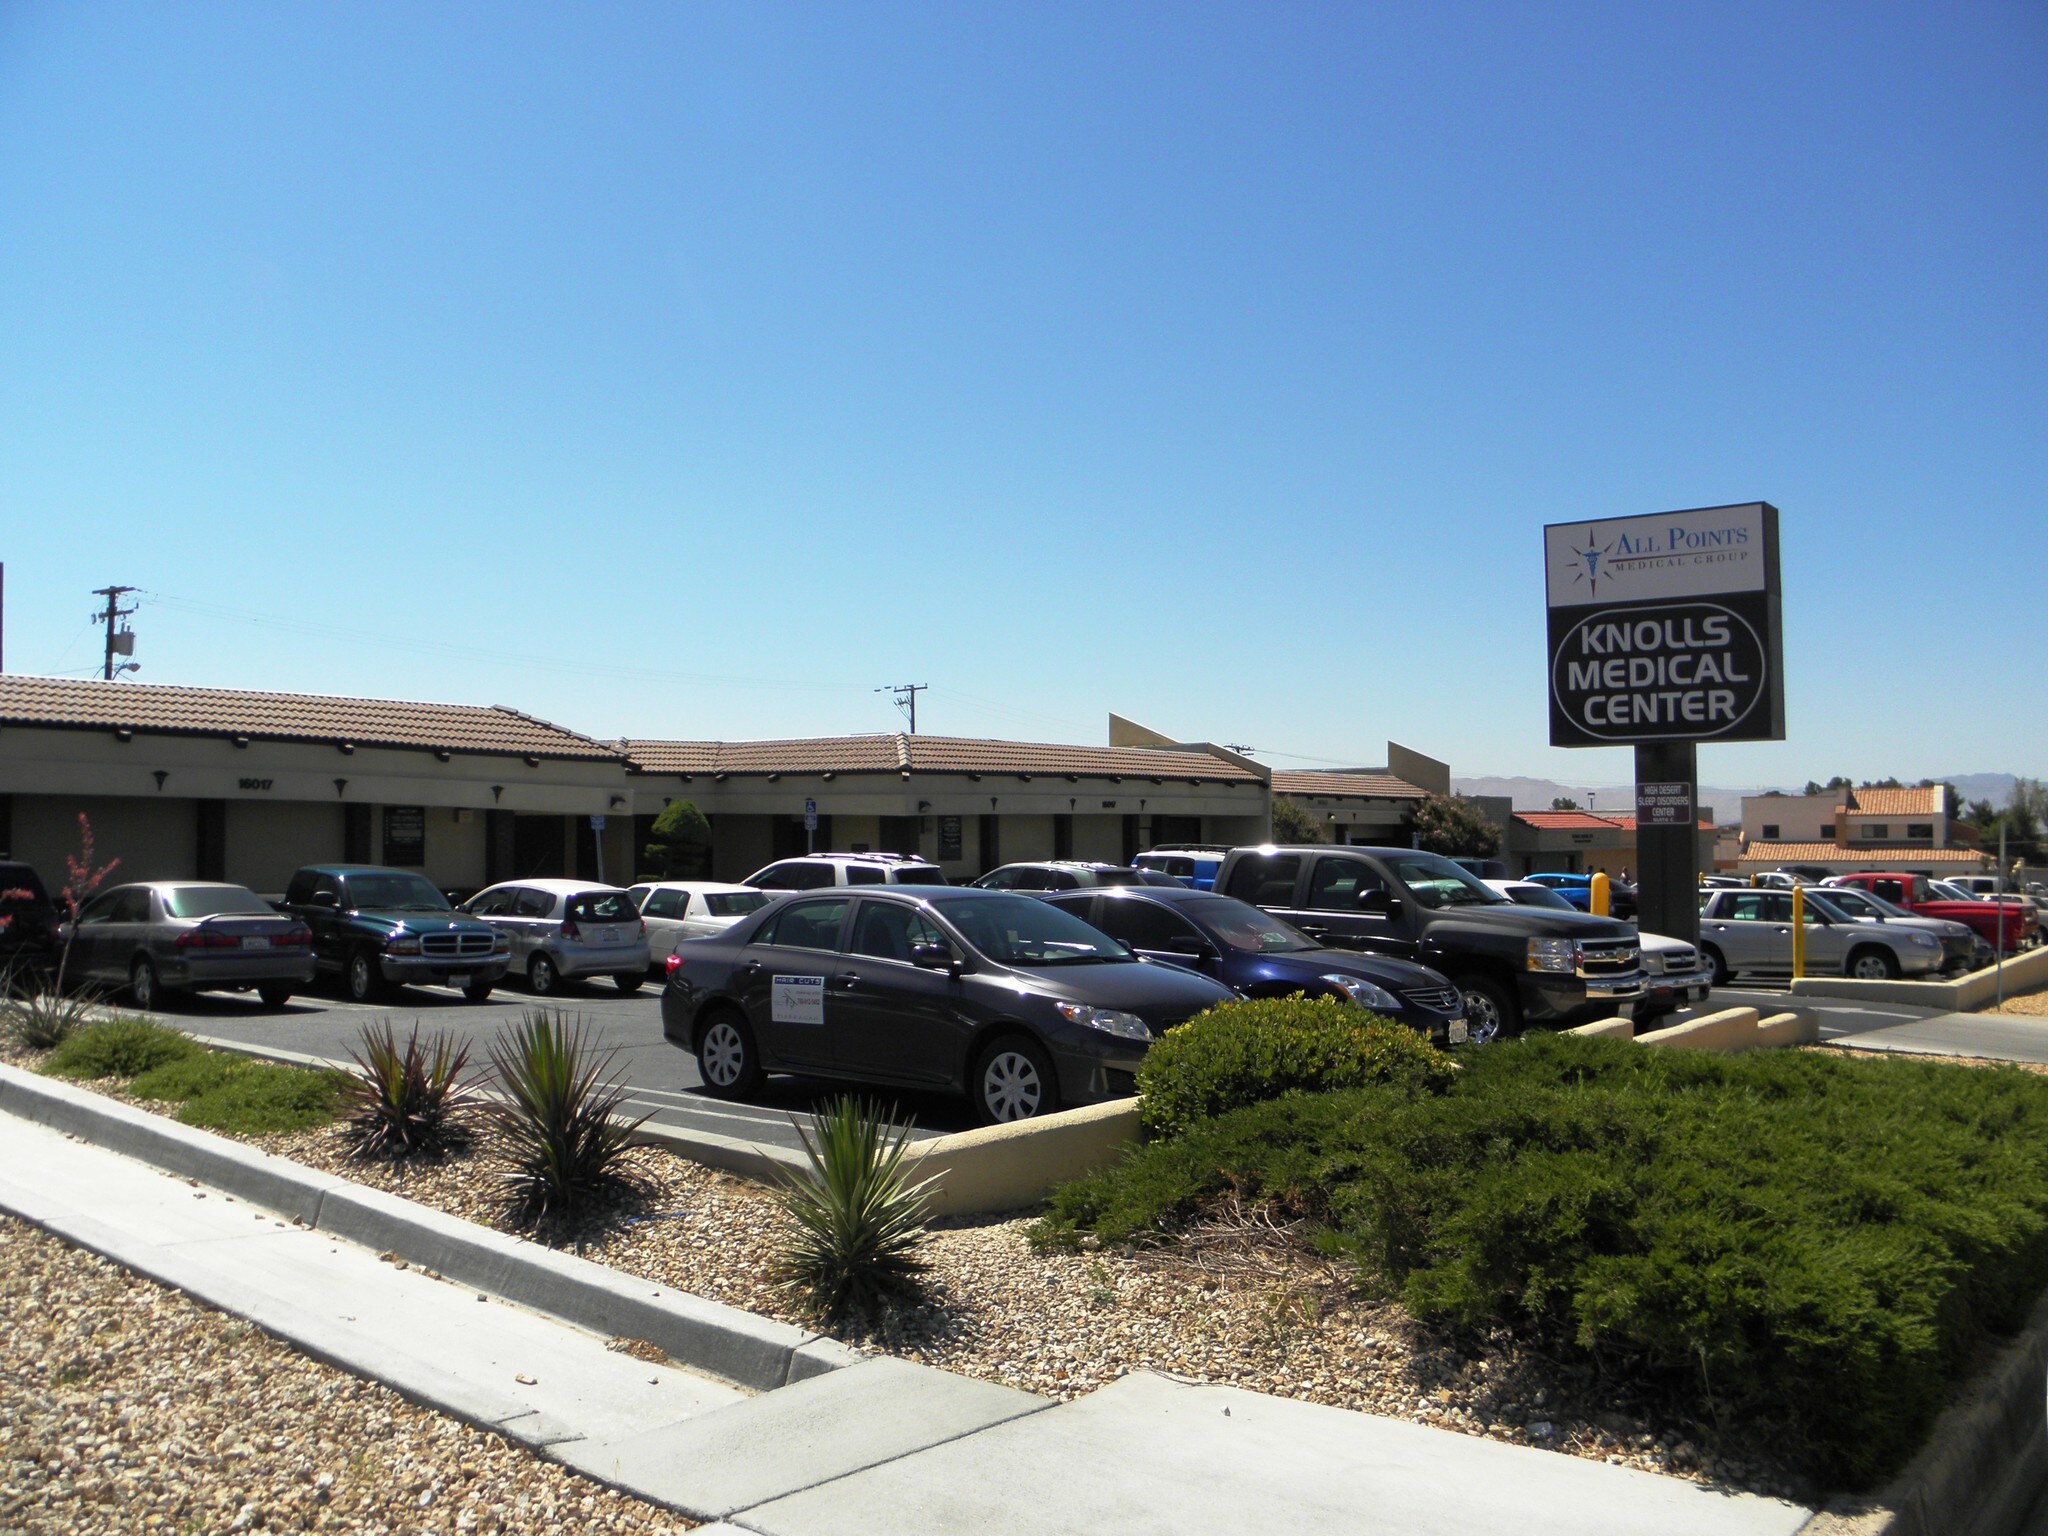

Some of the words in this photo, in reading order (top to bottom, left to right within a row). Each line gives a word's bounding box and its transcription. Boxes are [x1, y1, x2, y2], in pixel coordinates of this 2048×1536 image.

[1616, 532, 1661, 555] ALL
[1667, 526, 1748, 550] POINTS
[1615, 558, 1686, 572] MEDICAL
[1694, 551, 1748, 565] GROUP
[1581, 615, 1731, 655] KNOLLS
[1568, 652, 1749, 691] MEDICAL
[1583, 689, 1737, 726] CENTER
[1638, 796, 1656, 806] SLEEP
[1657, 795, 1689, 806] DISORDERS
[1644, 785, 1658, 795] HIGH
[1659, 784, 1682, 795] DESERT
[1652, 807, 1675, 817] CENTER
